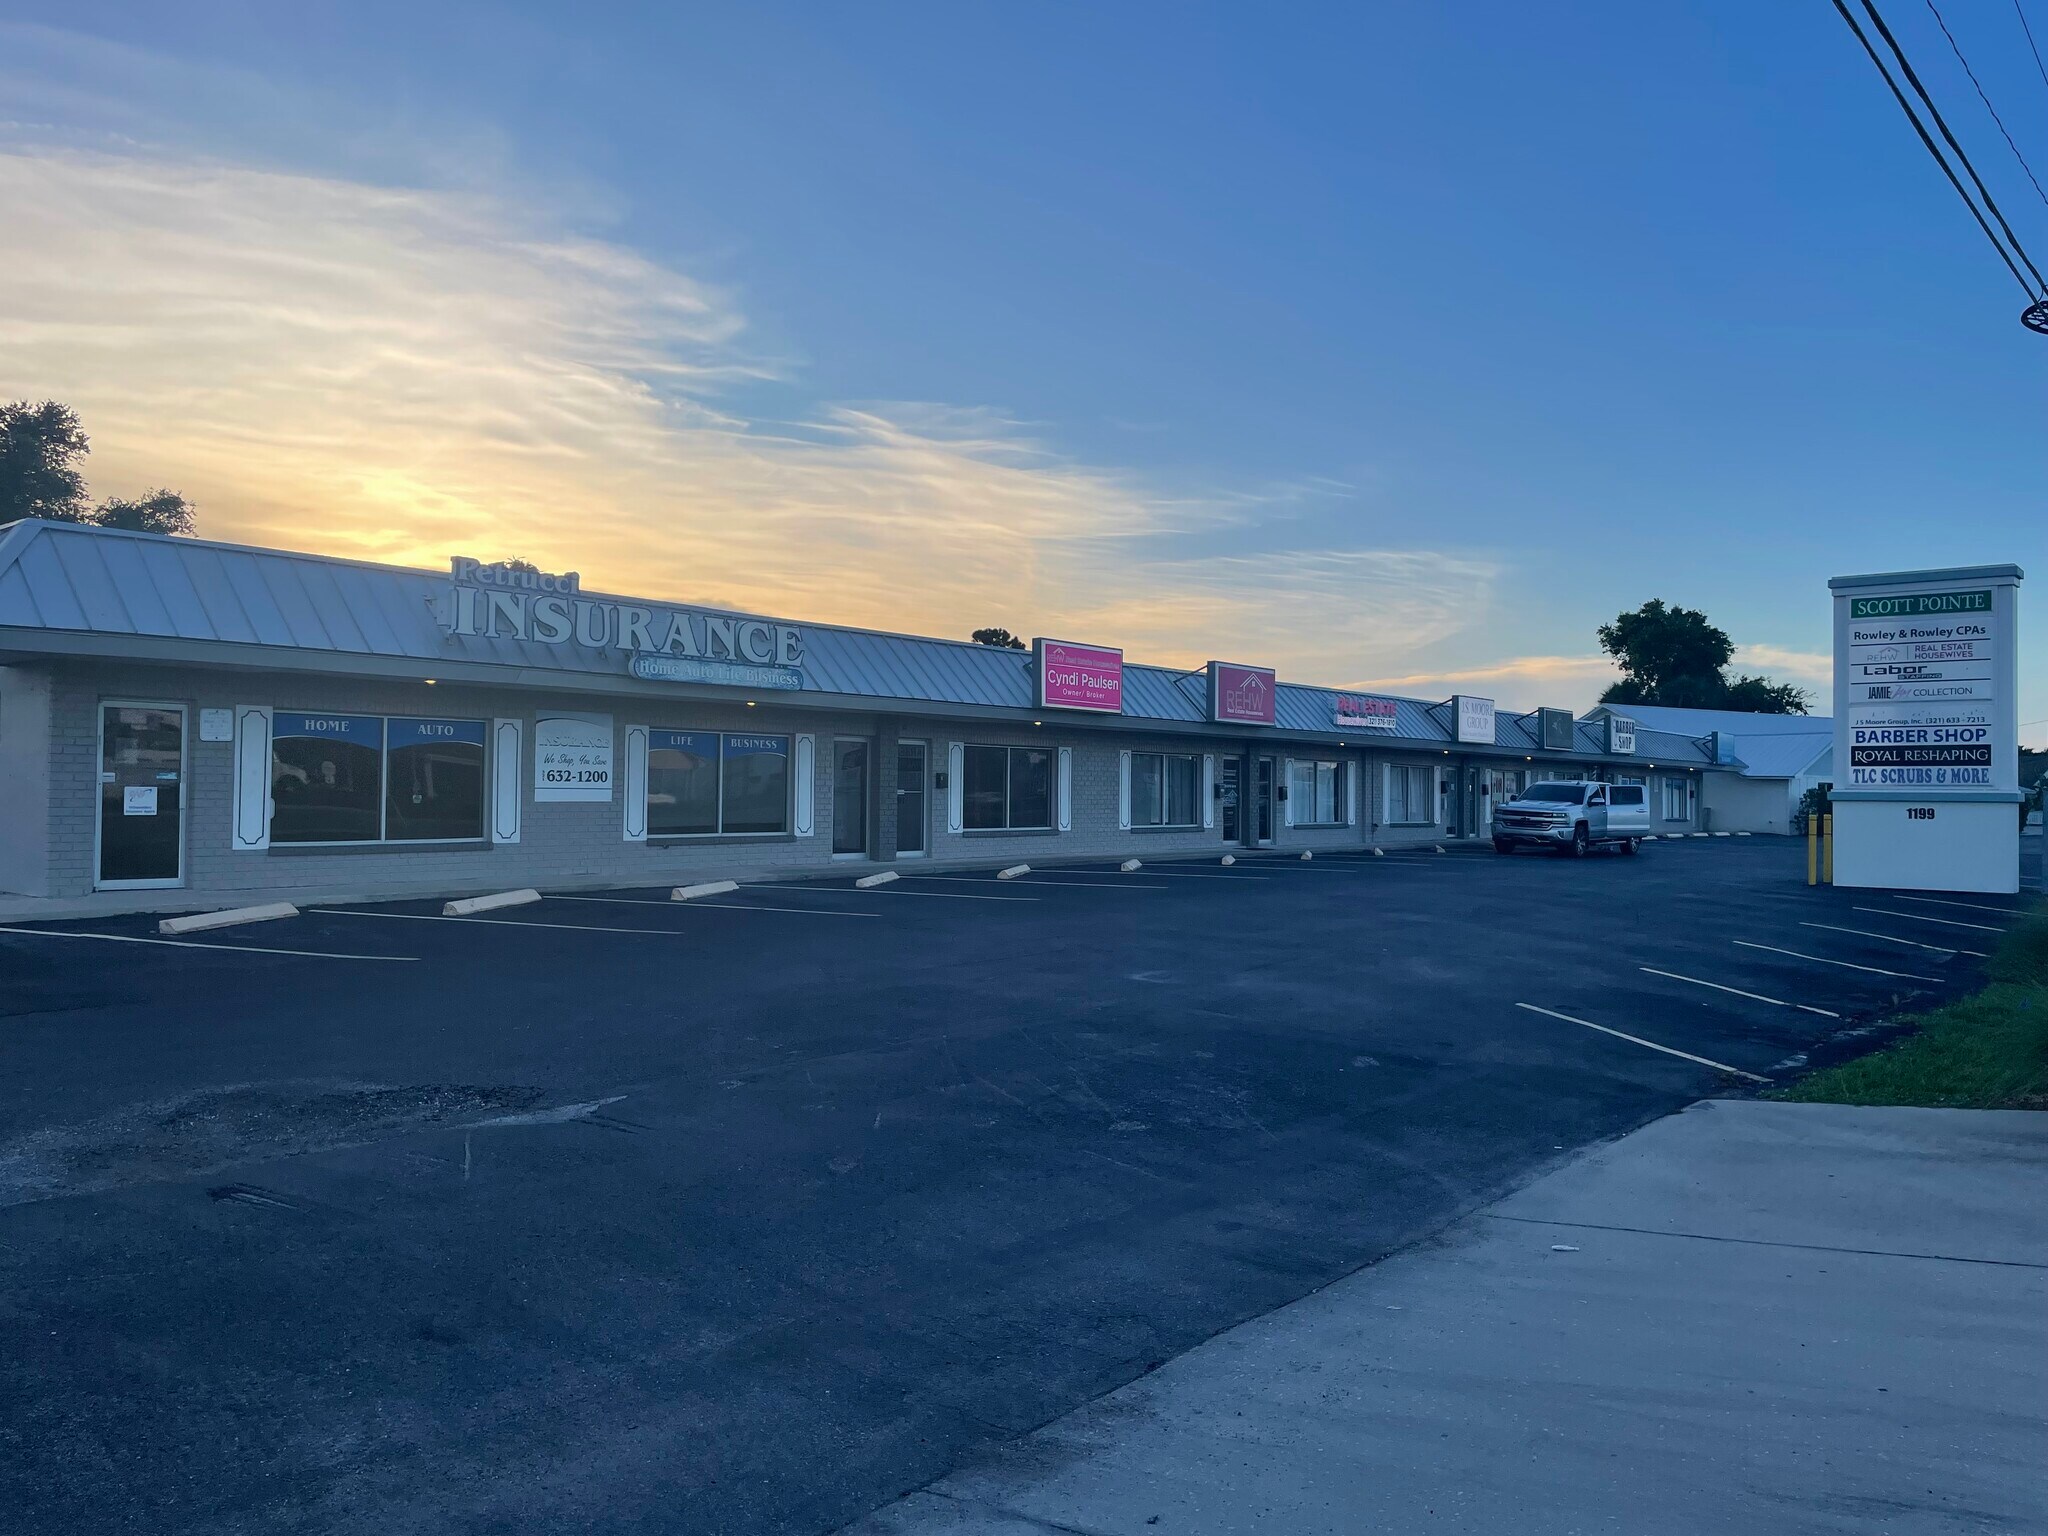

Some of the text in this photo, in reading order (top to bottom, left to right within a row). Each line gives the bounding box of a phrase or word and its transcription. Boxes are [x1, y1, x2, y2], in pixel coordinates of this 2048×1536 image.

[456, 558, 579, 594] Petrucci
[1857, 594, 1985, 615] SCOTT POINTE
[453, 586, 804, 666] INSURANCE
[1854, 625, 1986, 641] Rowley & Rowley CPAs
[1914, 642, 1973, 652] REAL ESTATE
[1914, 650, 1973, 659] HOUSEWIVES
[639, 658, 680, 676] Home
[684, 662, 714, 679] Auto
[745, 667, 799, 686] Business
[1863, 665, 1928, 676] Labor
[1048, 669, 1119, 690] Cyndi Paulsen
[1062, 688, 1105, 699] Owner/ Broker
[1226, 689, 1264, 711] REHW
[1867, 686, 1892, 700] JAMIE
[1913, 687, 1973, 697] COLLECTION
[1337, 696, 1397, 717] REAL ESTATE
[1471, 703, 1494, 716] MOORE
[304, 719, 350, 732] HOME
[1467, 716, 1488, 730] GROUP
[1925, 717, 1944, 725] (321)
[1946, 716, 1960, 724] 633
[417, 724, 454, 736] AUTO
[1855, 728, 1987, 743] BARBER SHOP
[670, 735, 693, 745] LIFE
[730, 738, 777, 749] BUSINESS
[543, 753, 555, 764] We
[579, 754, 590, 765] You
[592, 755, 607, 765] Save
[1855, 749, 1988, 763] ROYAL RESHAPING
[546, 769, 608, 783] 632-1200
[1853, 767, 1990, 783] TLC SCRUBS & MORE
[1906, 807, 1935, 819] 1199
